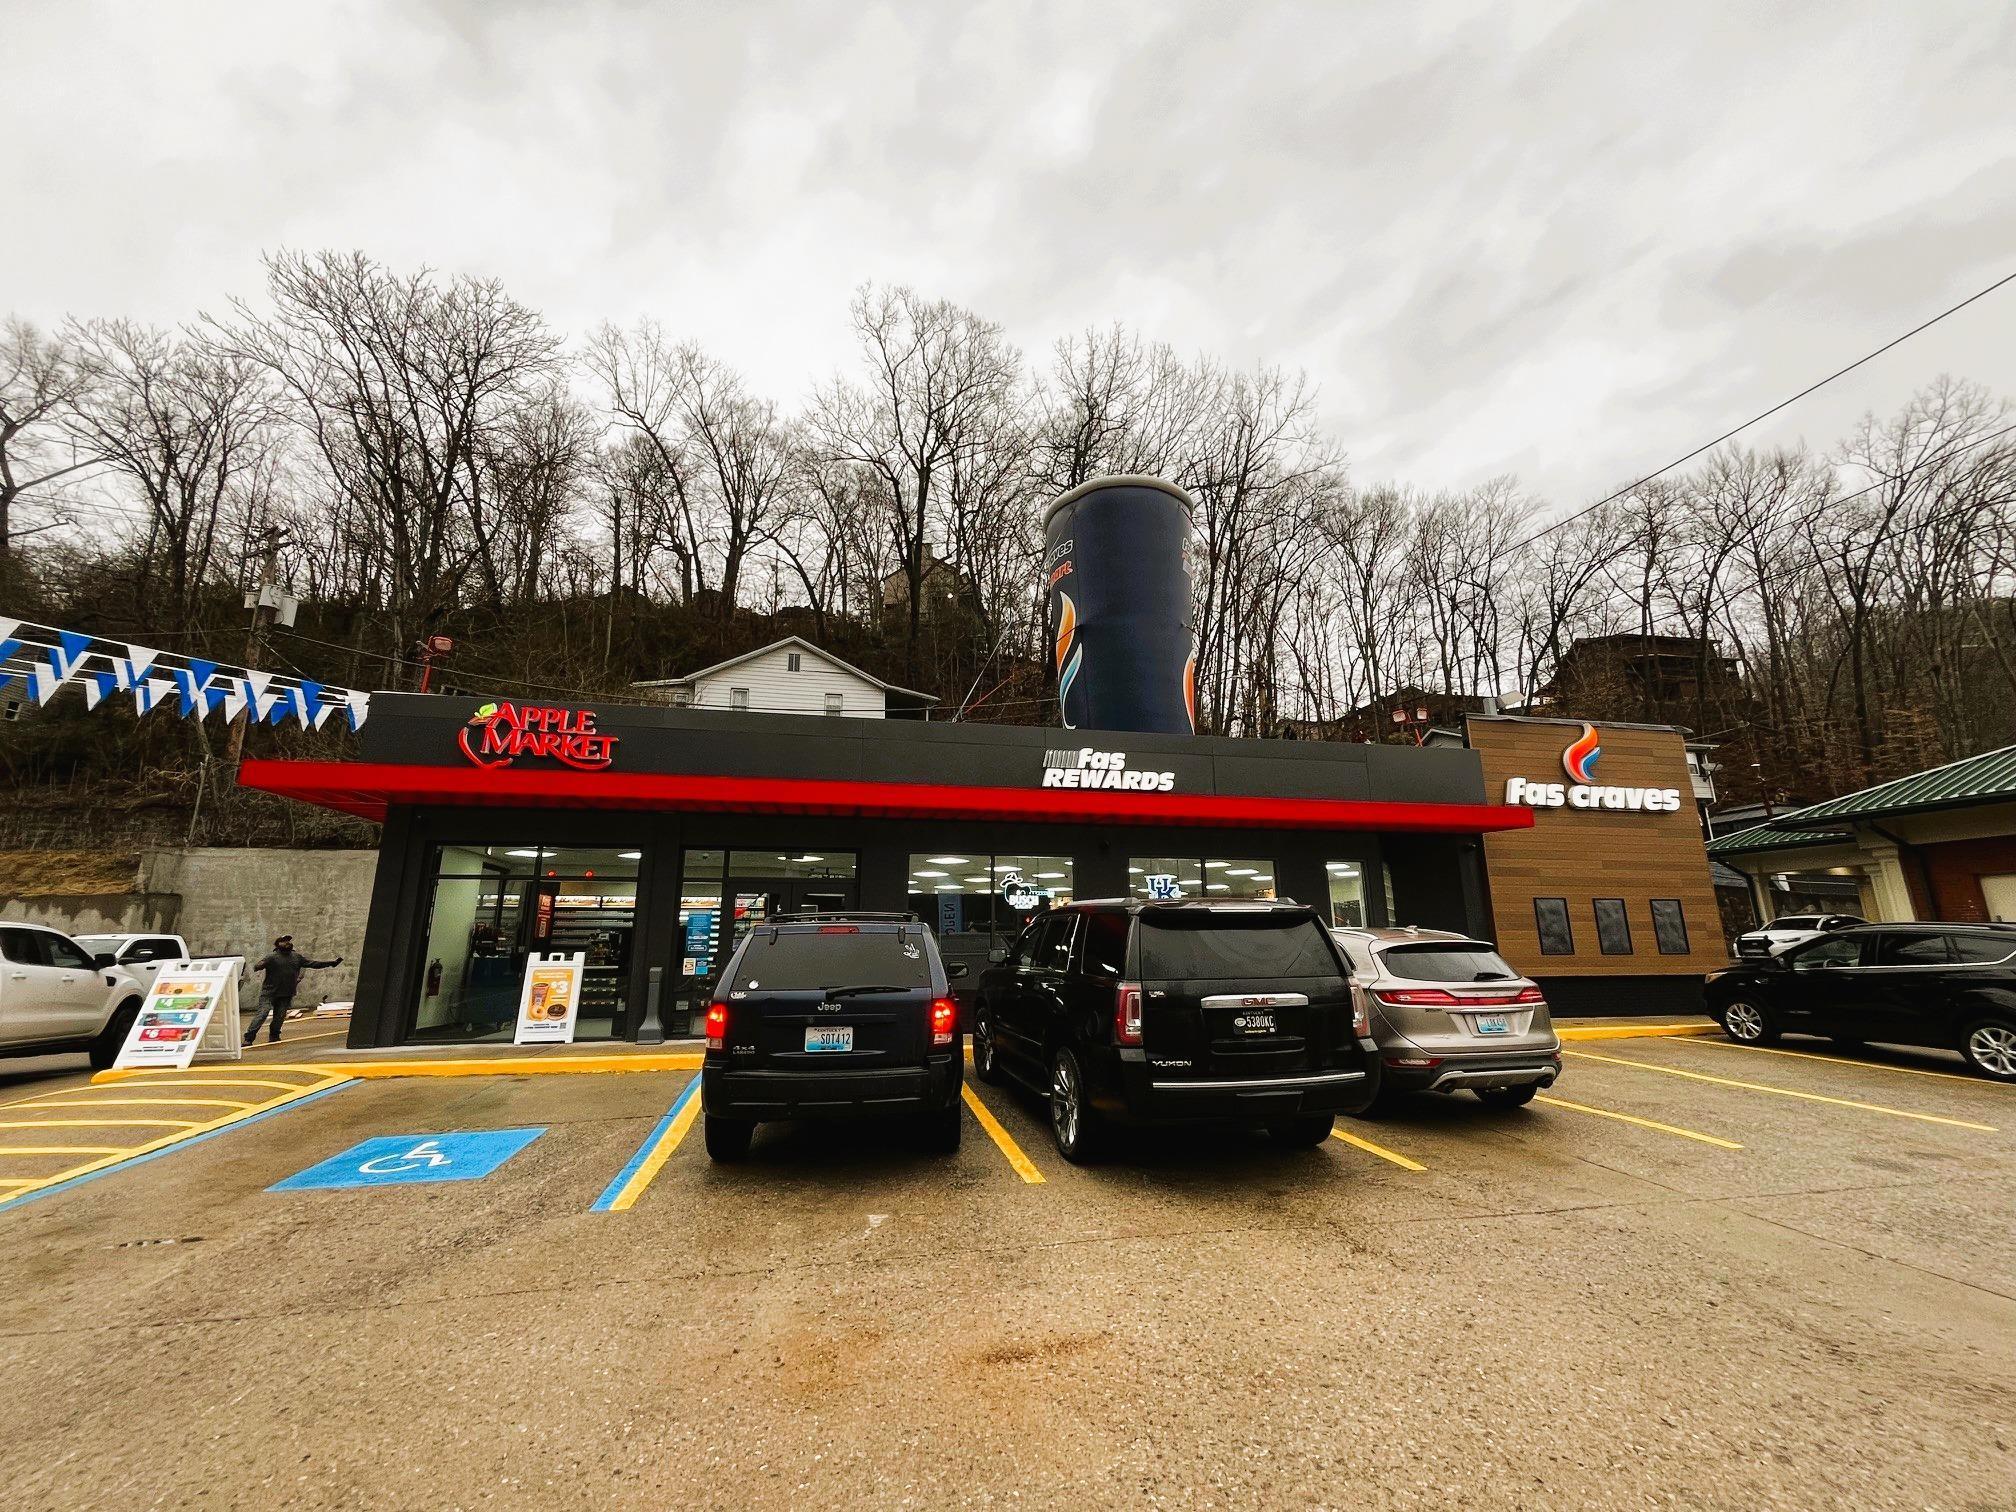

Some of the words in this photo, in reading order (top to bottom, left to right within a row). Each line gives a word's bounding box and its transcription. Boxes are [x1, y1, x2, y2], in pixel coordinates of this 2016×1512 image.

[486, 700, 597, 735] APPLE
[480, 728, 619, 767] MARKET
[1077, 748, 1126, 770] fas
[1042, 768, 1176, 791] REWARDS
[1506, 777, 1565, 807] fas
[1568, 784, 1681, 811] craves
[1009, 894, 1039, 906] BUSCH
[817, 1002, 842, 1011] Jeep
[1241, 997, 1277, 1006] GMC
